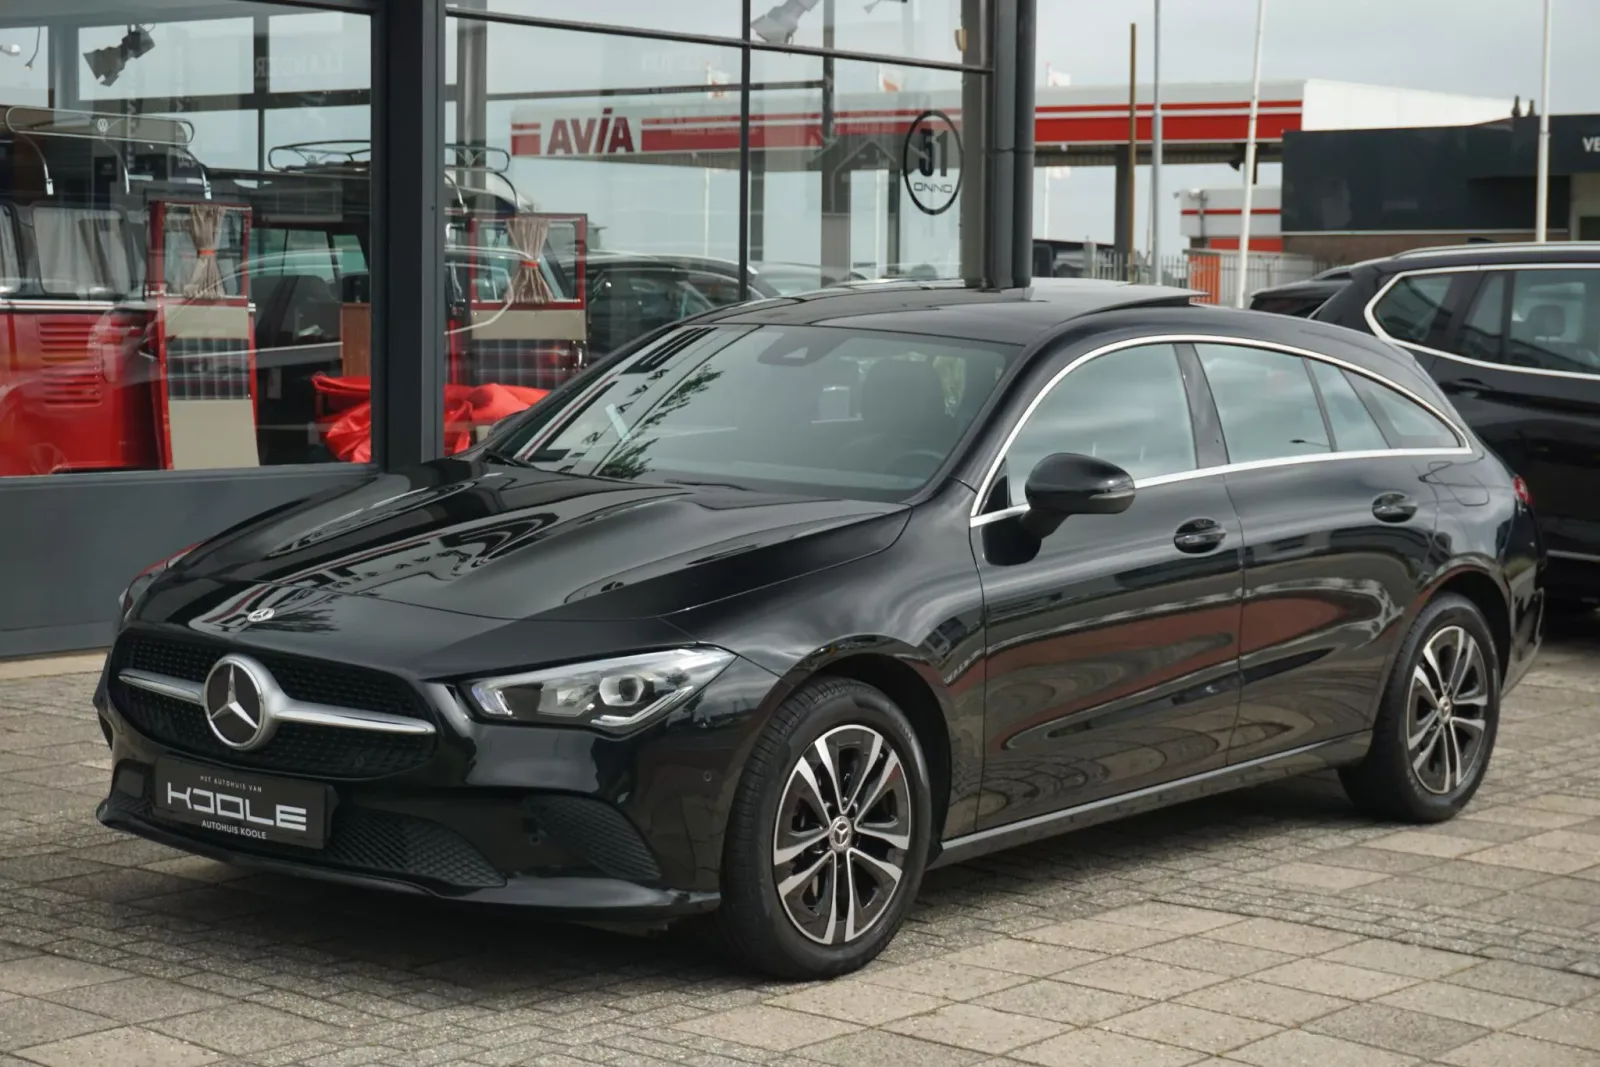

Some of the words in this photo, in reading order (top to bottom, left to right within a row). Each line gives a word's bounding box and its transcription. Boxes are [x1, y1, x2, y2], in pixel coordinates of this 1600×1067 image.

[919, 128, 948, 177] 51
[914, 182, 953, 193] ONNO
[214, 778, 246, 791] AUTOHUIS
[249, 785, 262, 793] VAN
[167, 782, 307, 832] KOOLE
[201, 820, 239, 835] AUTOHUIS
[240, 828, 267, 840] KOOLE
